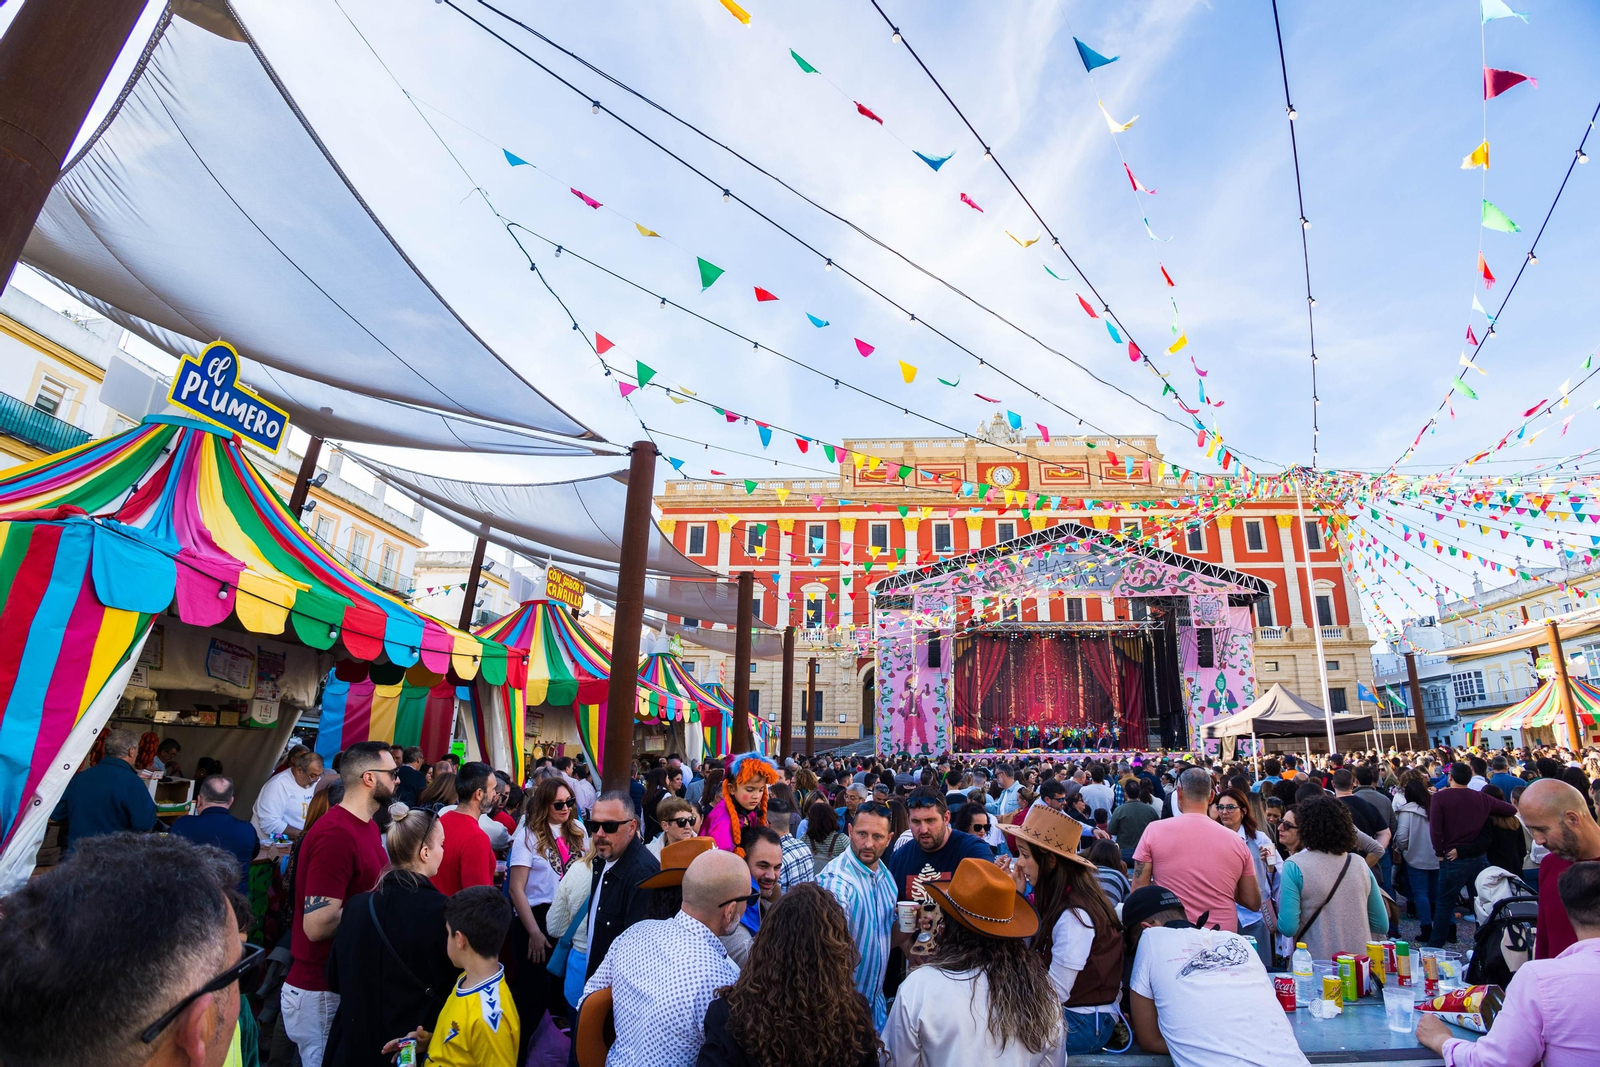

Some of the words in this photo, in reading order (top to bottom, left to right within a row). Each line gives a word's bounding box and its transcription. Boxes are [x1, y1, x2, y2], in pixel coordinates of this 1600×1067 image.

[207, 356, 231, 387] el
[181, 370, 280, 438] PLUMERO
[1037, 560, 1084, 573] PLAZA
[549, 570, 562, 584] CON
[562, 576, 580, 593] SABOR
[580, 584, 584, 595] A
[1036, 574, 1110, 587] CARNAVAL
[546, 582, 582, 608] CAÑAILLA
